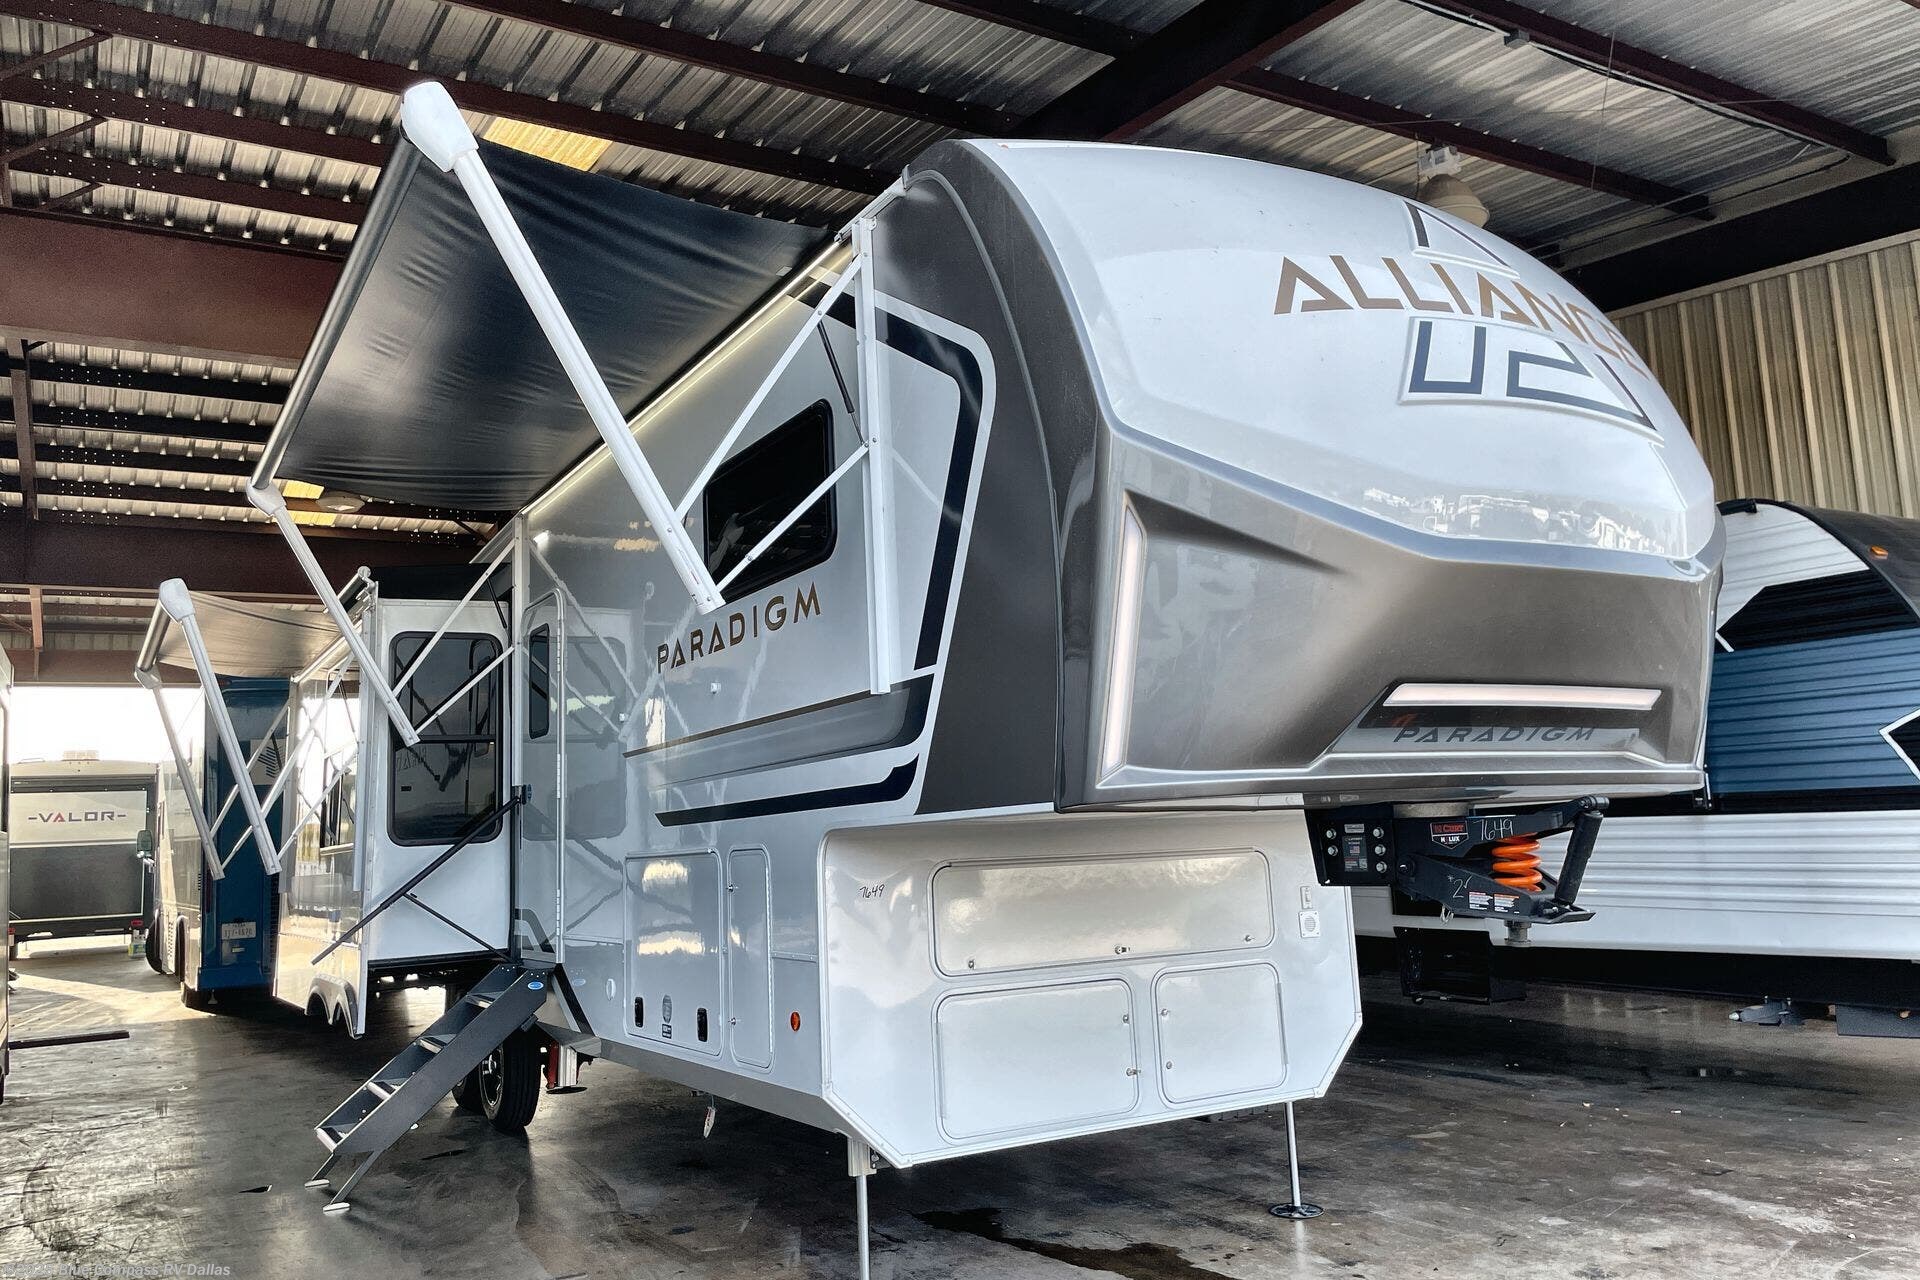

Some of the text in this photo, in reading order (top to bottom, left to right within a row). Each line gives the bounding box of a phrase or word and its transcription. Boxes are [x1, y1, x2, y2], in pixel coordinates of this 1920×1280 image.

[657, 581, 822, 674] PARADIGM
[1393, 725, 1596, 743] PARADIGM
[1472, 817, 1514, 841] 7649
[859, 883, 886, 899] 7649
